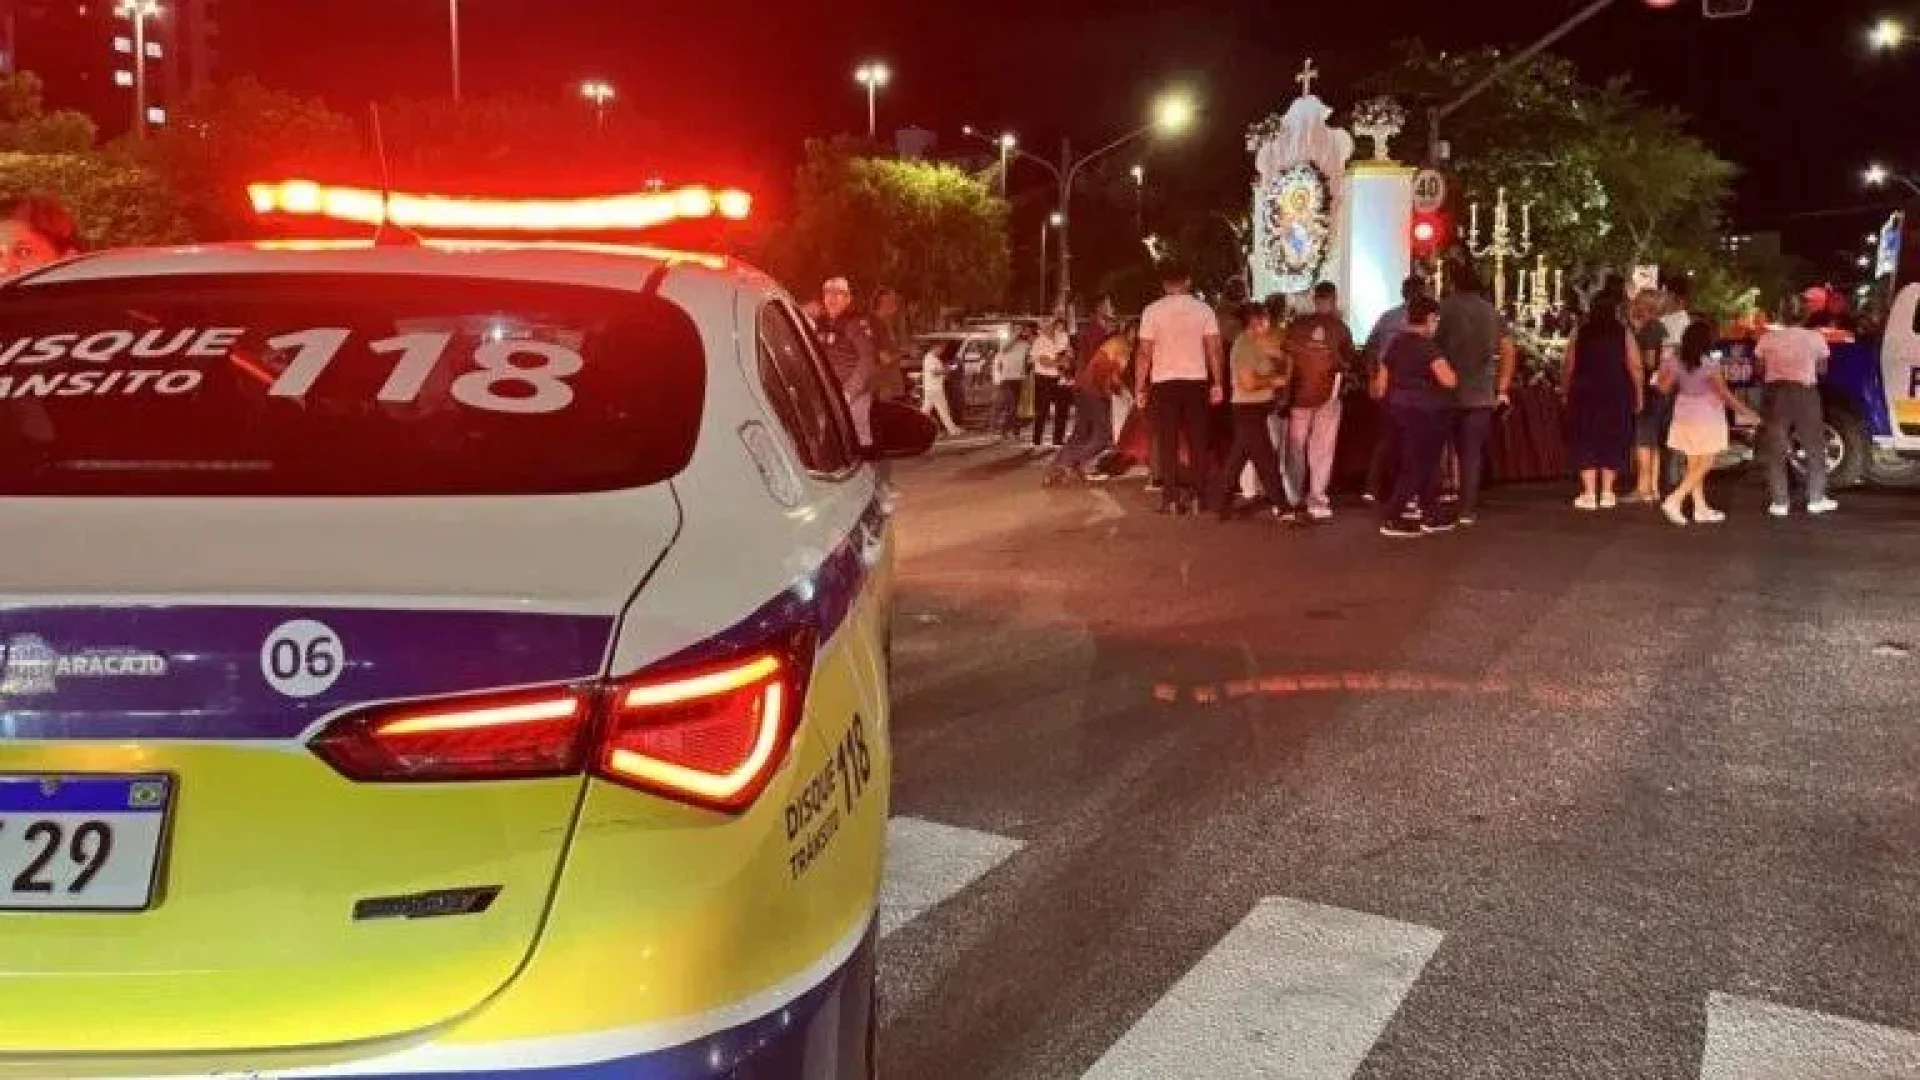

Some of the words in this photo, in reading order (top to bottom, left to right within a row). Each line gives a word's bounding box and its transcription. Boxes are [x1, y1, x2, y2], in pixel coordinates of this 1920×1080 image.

[0, 326, 247, 366] ISQUE
[267, 327, 585, 415] 118
[270, 637, 334, 680] 06
[785, 757, 836, 840] DISQUE
[837, 711, 871, 815] 118
[0, 820, 114, 893] 29
